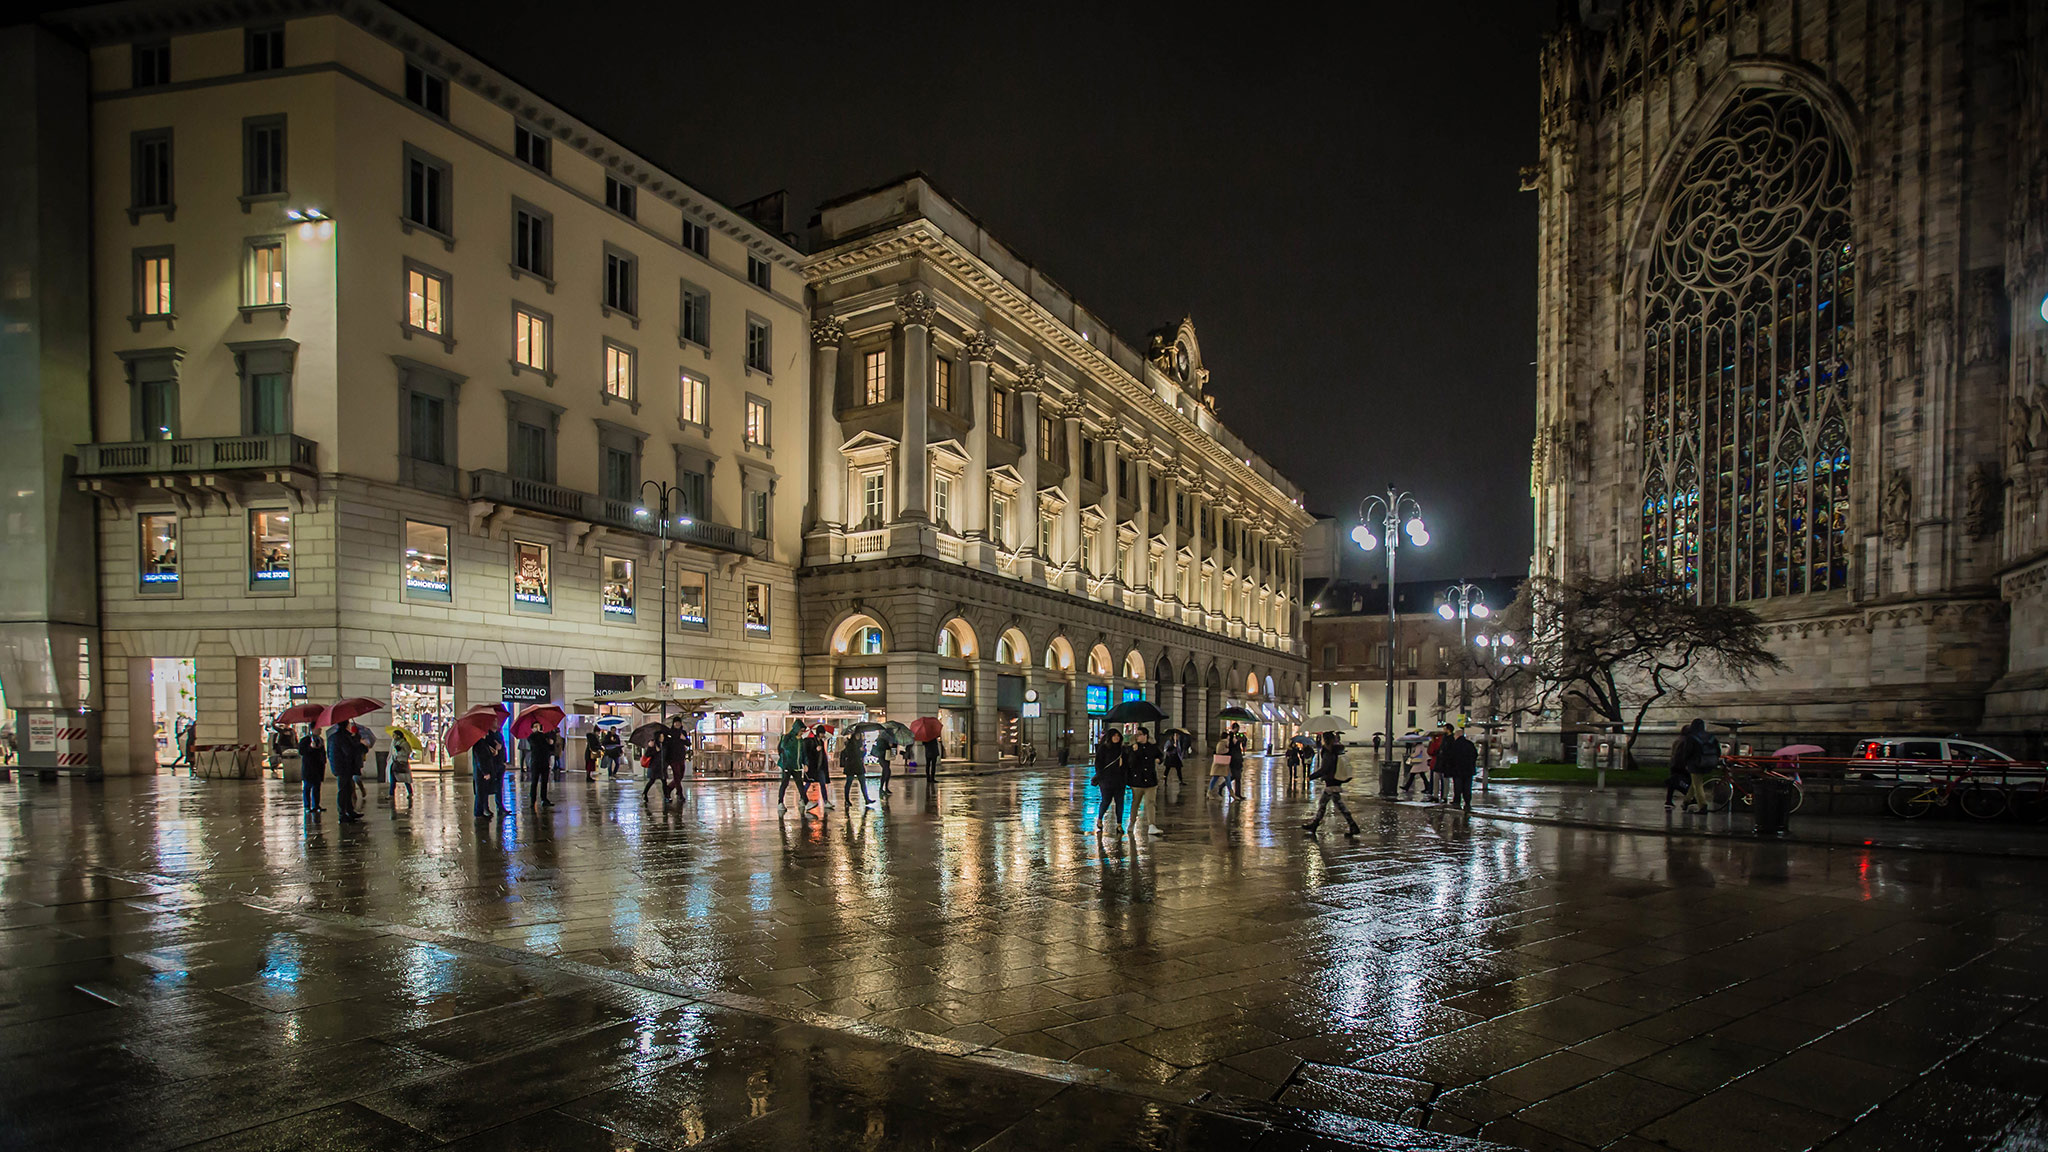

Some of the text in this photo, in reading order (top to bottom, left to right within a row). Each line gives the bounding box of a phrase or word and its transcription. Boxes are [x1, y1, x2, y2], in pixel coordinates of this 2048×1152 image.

[407, 579, 447, 591] SIGNORVINO
[516, 593, 546, 603] WINE STORE
[392, 667, 448, 677] timissimi
[845, 677, 879, 691] LUSH
[942, 679, 967, 693] LUSH
